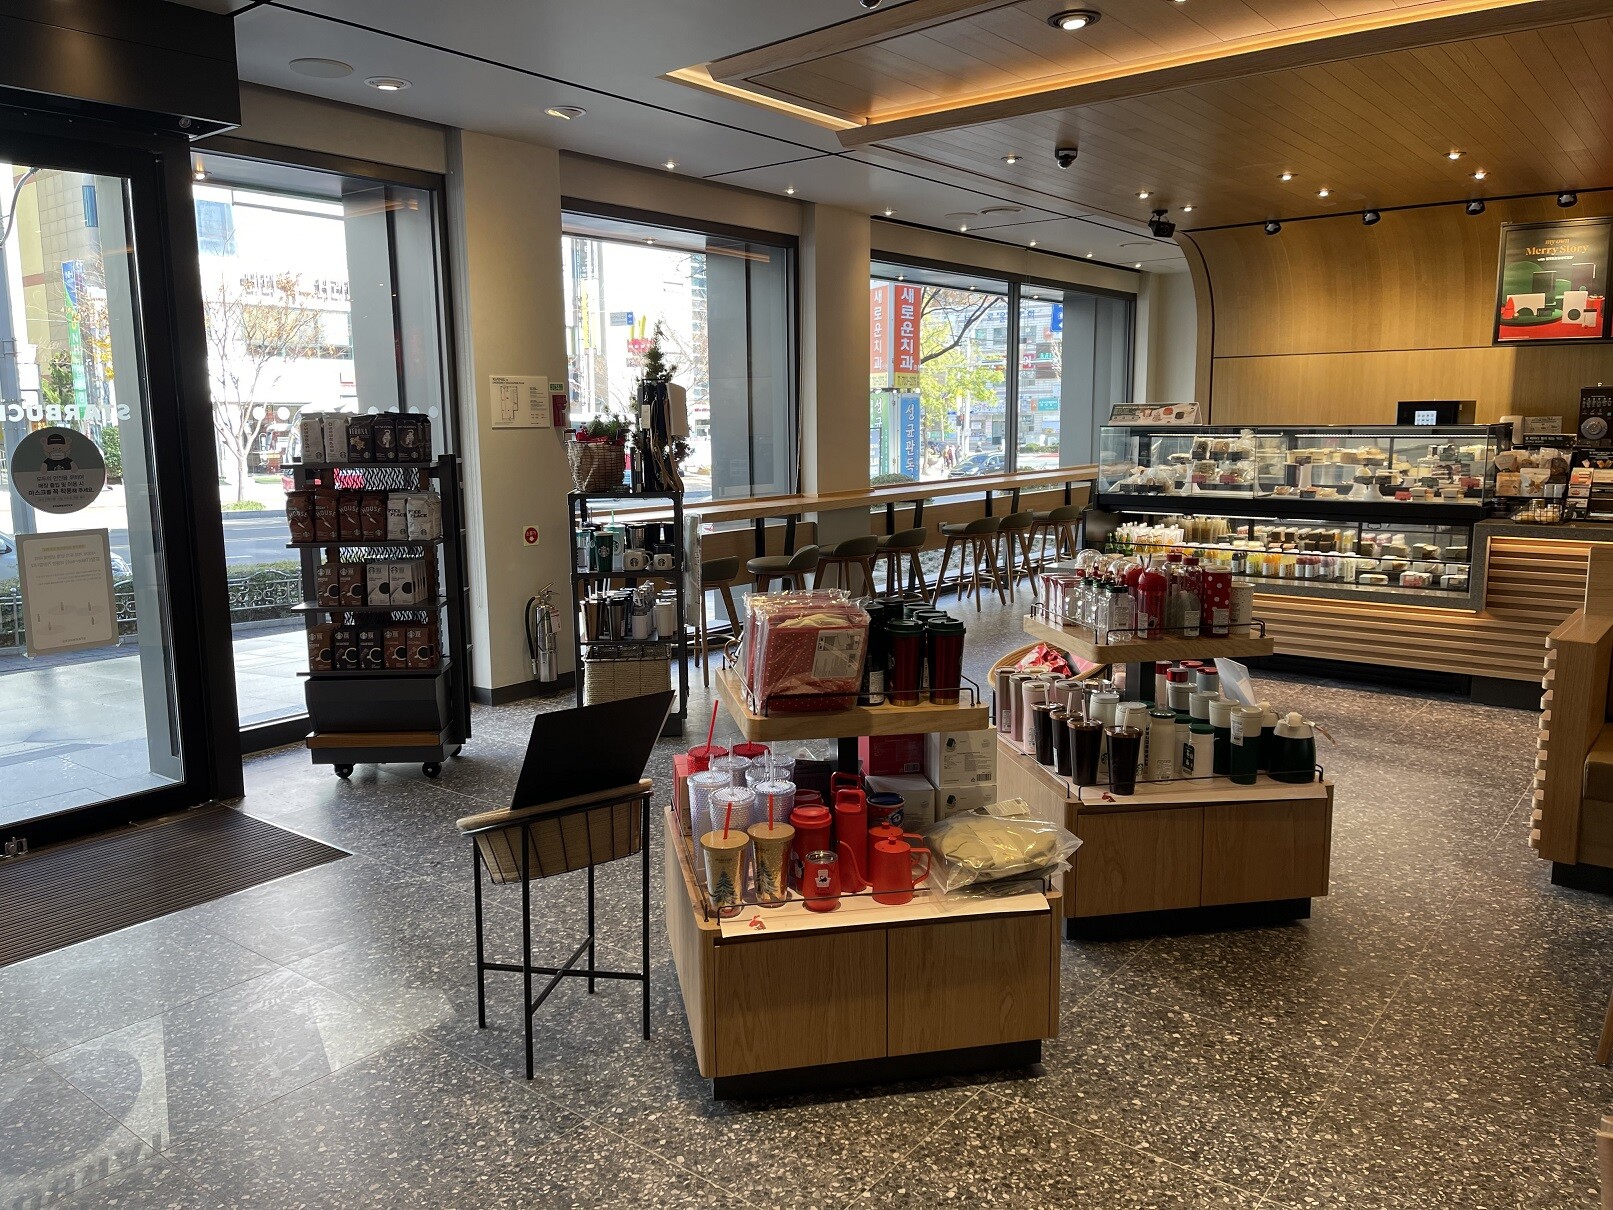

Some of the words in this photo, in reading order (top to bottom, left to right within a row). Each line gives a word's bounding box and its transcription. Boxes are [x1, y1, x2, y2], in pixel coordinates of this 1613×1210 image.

[1526, 247, 1560, 256] Merry
[1560, 245, 1590, 254] Story
[874, 290, 883, 371] 새로운치과
[900, 286, 915, 371] 새로운치과
[339, 505, 359, 513] HOUSE
[361, 505, 382, 513] HOUSE
[288, 510, 308, 518] HOUSE
[316, 510, 336, 518] HOUSE
